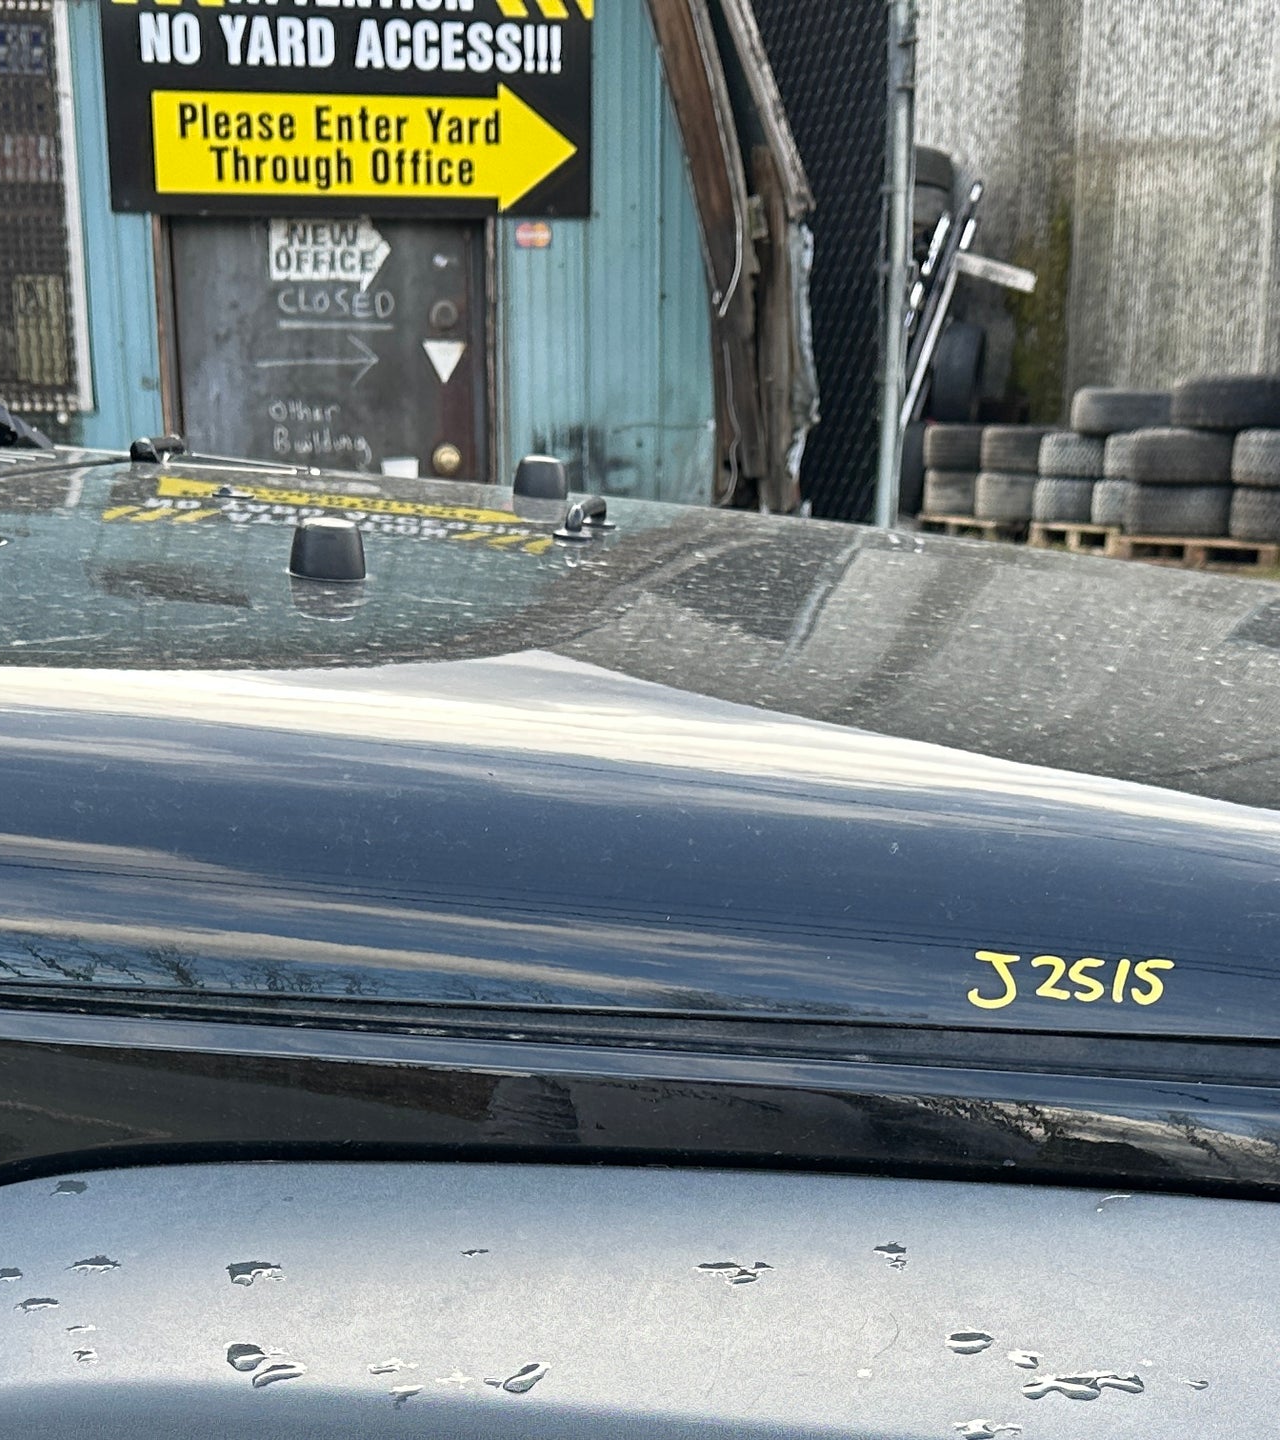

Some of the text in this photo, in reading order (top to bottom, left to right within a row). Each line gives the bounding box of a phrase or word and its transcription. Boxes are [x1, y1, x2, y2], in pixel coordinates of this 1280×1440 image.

[138, 11, 563, 74] NO YARD ACCESS!!!
[177, 102, 501, 146] Please Enter Yard
[208, 146, 475, 190] Through Office
[287, 223, 360, 246] NEW
[275, 246, 377, 273] OFFICE
[277, 287, 396, 319] CLOSED
[968, 951, 1174, 1009] J2515
